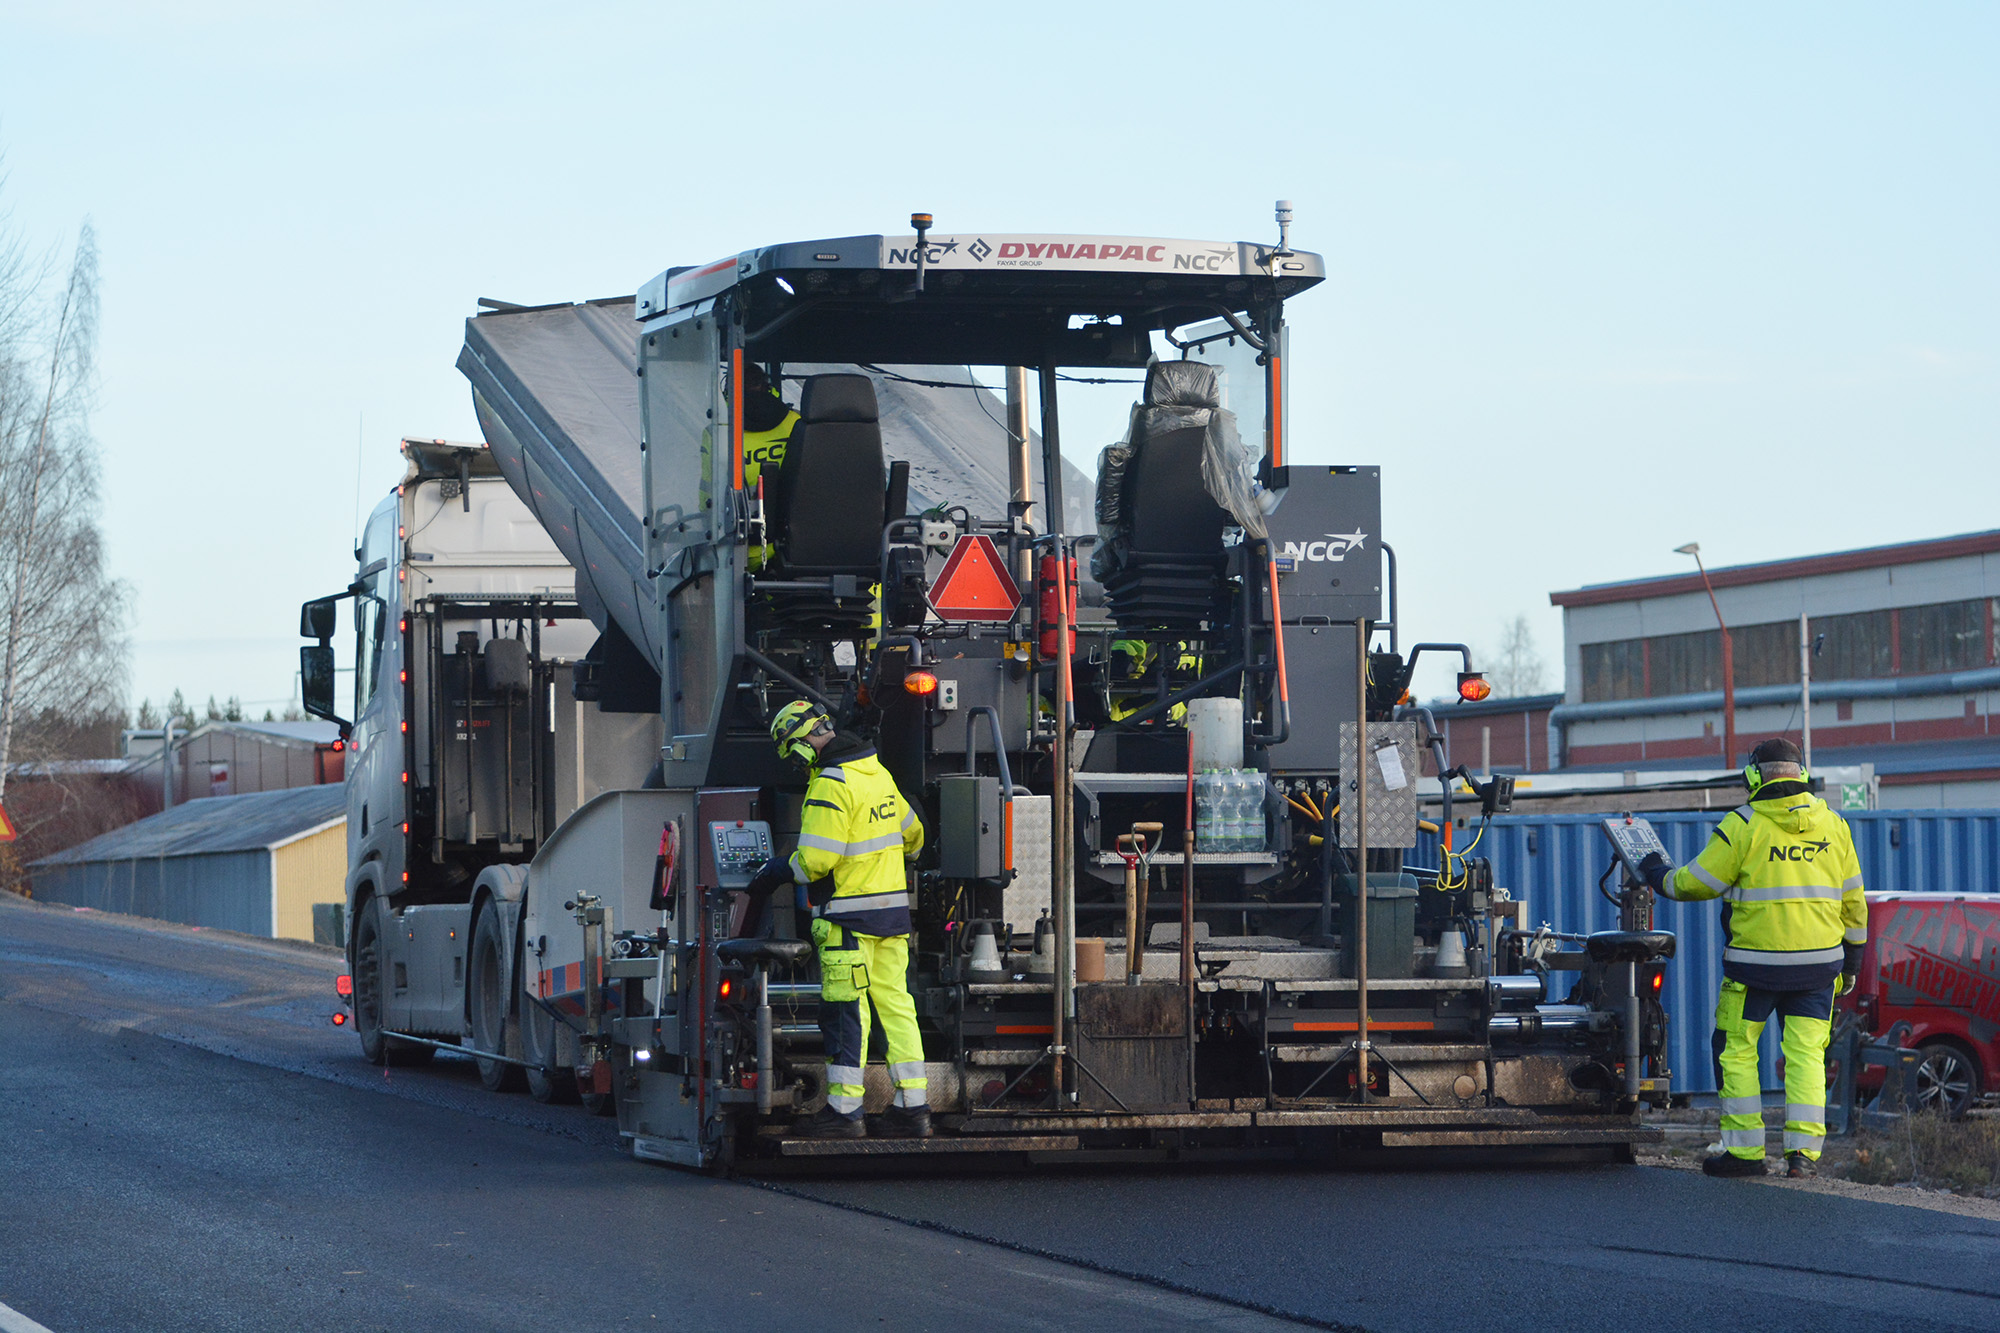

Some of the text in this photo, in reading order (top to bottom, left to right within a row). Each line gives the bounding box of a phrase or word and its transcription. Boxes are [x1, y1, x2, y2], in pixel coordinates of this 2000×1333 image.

[997, 243, 1166, 262] DYNAPAC
[1173, 253, 1221, 271] NCC
[1284, 541, 1347, 562] NCC
[1768, 845, 1815, 863] NCC
